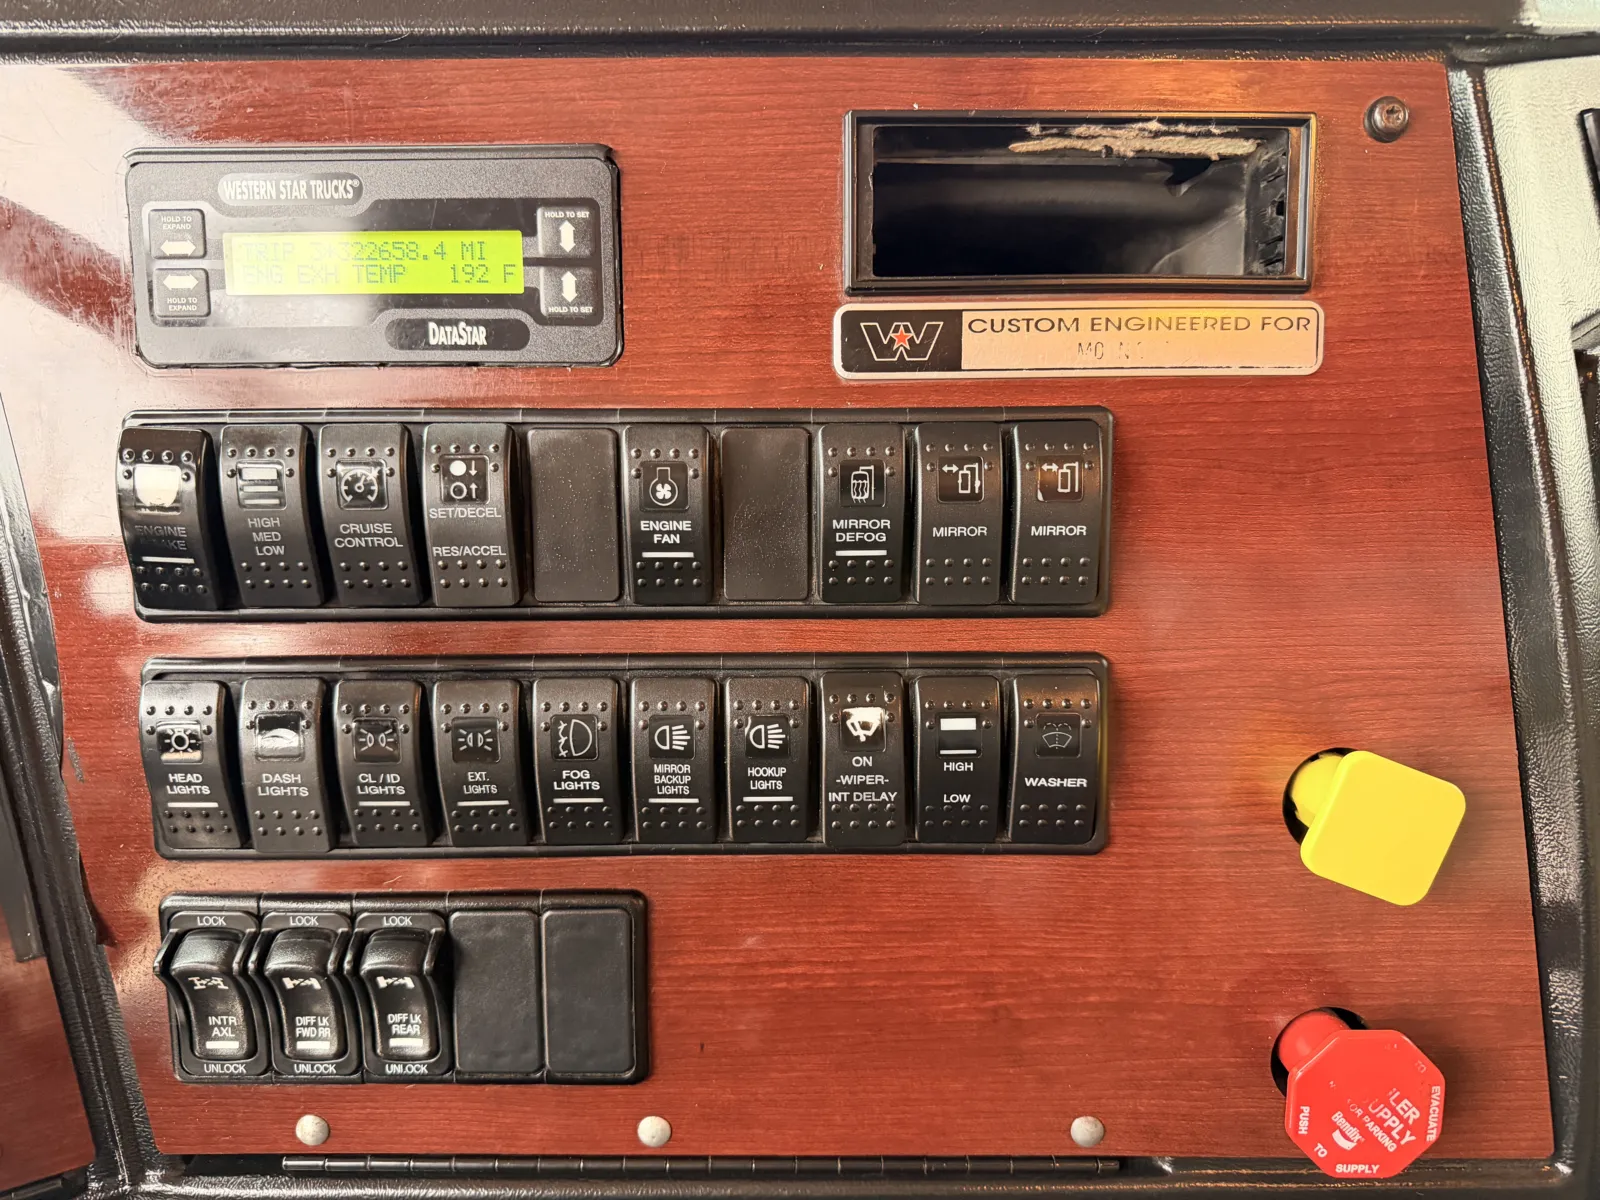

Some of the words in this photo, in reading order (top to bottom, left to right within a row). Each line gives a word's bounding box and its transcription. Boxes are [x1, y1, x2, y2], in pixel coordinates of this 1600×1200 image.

[223, 180, 277, 200] WESTERN
[279, 179, 308, 200] STAR
[242, 241, 295, 261] TRIP
[461, 241, 485, 261] MI
[243, 264, 283, 284] ENG
[297, 264, 340, 284] EXH
[352, 264, 406, 284] TEMP
[450, 264, 489, 284] 192
[503, 264, 516, 284] F
[967, 317, 1079, 333] CUSTOM
[1090, 316, 1251, 332] ENGINEERED
[1261, 316, 1311, 331] FOR
[429, 507, 502, 519] SET/DECEL
[247, 517, 280, 528] HIGH
[640, 521, 692, 532] ENGINE
[832, 519, 891, 530] MIRROR
[135, 525, 187, 537] ENGINE
[339, 523, 393, 534] CRUISE
[932, 526, 988, 537] MIRROR
[1031, 525, 1087, 537] MIRROR
[252, 531, 281, 542] MED
[653, 533, 681, 544] FAN
[835, 532, 887, 543] DEFOG
[334, 537, 404, 548] CONTROL
[255, 545, 285, 556] LOW
[433, 545, 507, 557] RES/ACCEL
[851, 756, 873, 767] ON
[943, 762, 974, 772] HIGH
[562, 769, 590, 780] FOG
[653, 764, 691, 774] MIRROR
[747, 767, 787, 778] HOOKUP
[168, 773, 203, 783] HEAD
[262, 773, 302, 784] DASH
[358, 773, 378, 784] CL
[386, 773, 401, 784] ID
[467, 771, 490, 782] EXT.
[653, 775, 691, 784] BACKUP
[553, 781, 601, 791] LIGHTS
[750, 779, 783, 790] LIGHTS
[1024, 777, 1088, 788] WASHER
[166, 785, 211, 795] LIGHTS
[257, 786, 309, 797] LIGHTS
[357, 785, 406, 795] LIGHTS
[463, 784, 498, 795] LIGHTS
[656, 785, 690, 795] LIGHTS
[828, 792, 850, 802] INT
[853, 792, 898, 802] DELAY
[943, 794, 971, 803] LOW
[197, 916, 227, 926] LOCK
[289, 915, 319, 926] LOCK
[383, 915, 413, 926] LOCK
[208, 1015, 237, 1026] INTR
[295, 1015, 316, 1026] DIFF
[318, 1016, 329, 1026] LK
[388, 1013, 408, 1024] DIFF
[410, 1013, 422, 1024] LK
[211, 1027, 236, 1037] AXL
[296, 1027, 317, 1037] FWD
[318, 1027, 331, 1037] RR
[391, 1024, 420, 1035] REAR
[204, 1063, 247, 1074] UNLOCK
[294, 1063, 336, 1074] UNLOCK
[385, 1064, 428, 1074] UNLOCK
[1426, 1085, 1441, 1142] EVACUATE
[1331, 1111, 1363, 1143] Bendix
[1347, 1098, 1364, 1118] OR
[1362, 1115, 1397, 1152] PARKING
[1363, 1098, 1416, 1145] UPPLY
[1298, 1105, 1310, 1135] PUSH
[1313, 1142, 1328, 1158] TO
[1335, 1163, 1380, 1174] SUPPLY
